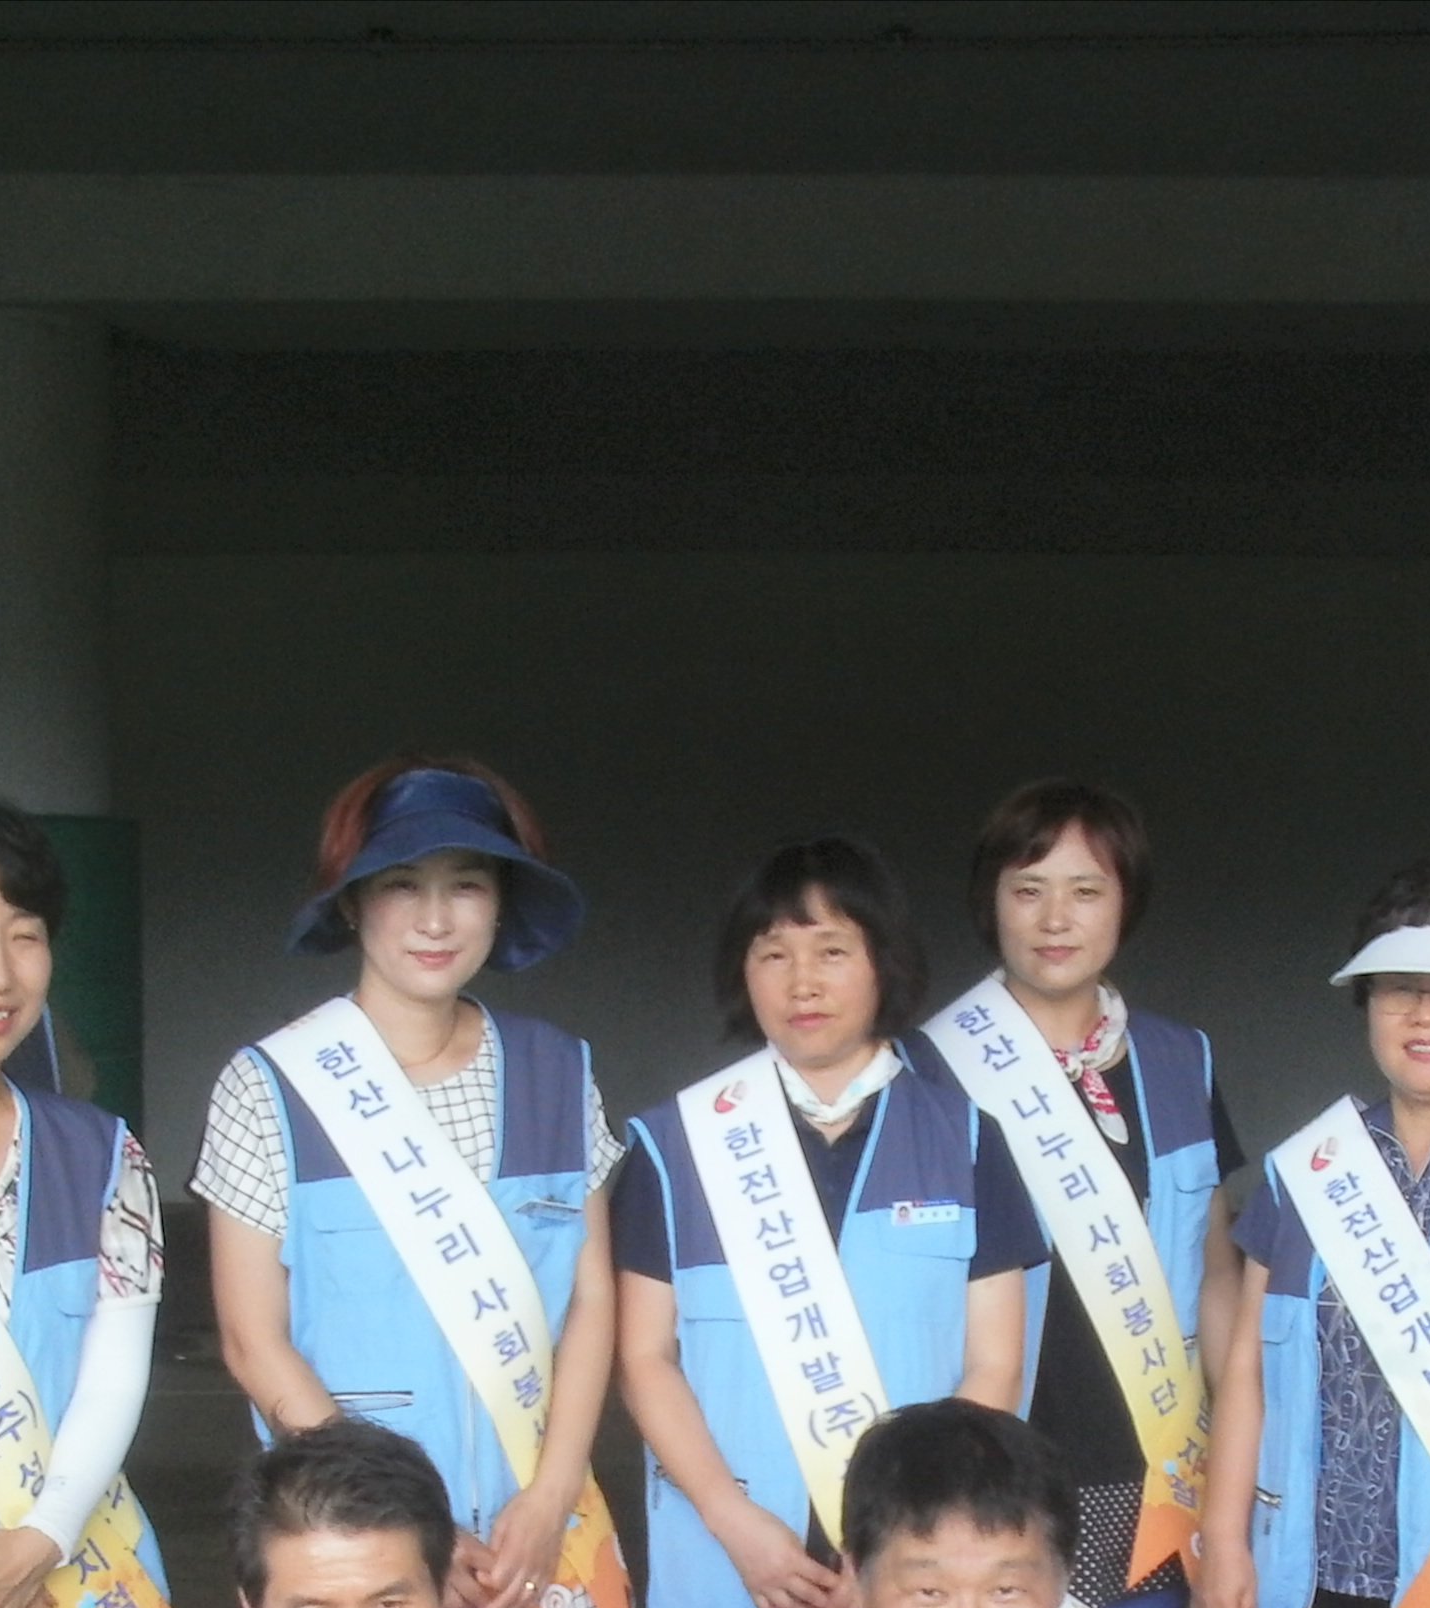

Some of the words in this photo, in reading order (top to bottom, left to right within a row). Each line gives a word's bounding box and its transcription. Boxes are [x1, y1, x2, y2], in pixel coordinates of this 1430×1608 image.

[314, 1039, 391, 1121] 한산
[382, 1135, 481, 1266] 나누리
[471, 1277, 547, 1440] 사회봉
[953, 1002, 1021, 1072] 한산
[1011, 1085, 1100, 1201] 나누리
[1088, 1215, 1178, 1418] 사회봉사단
